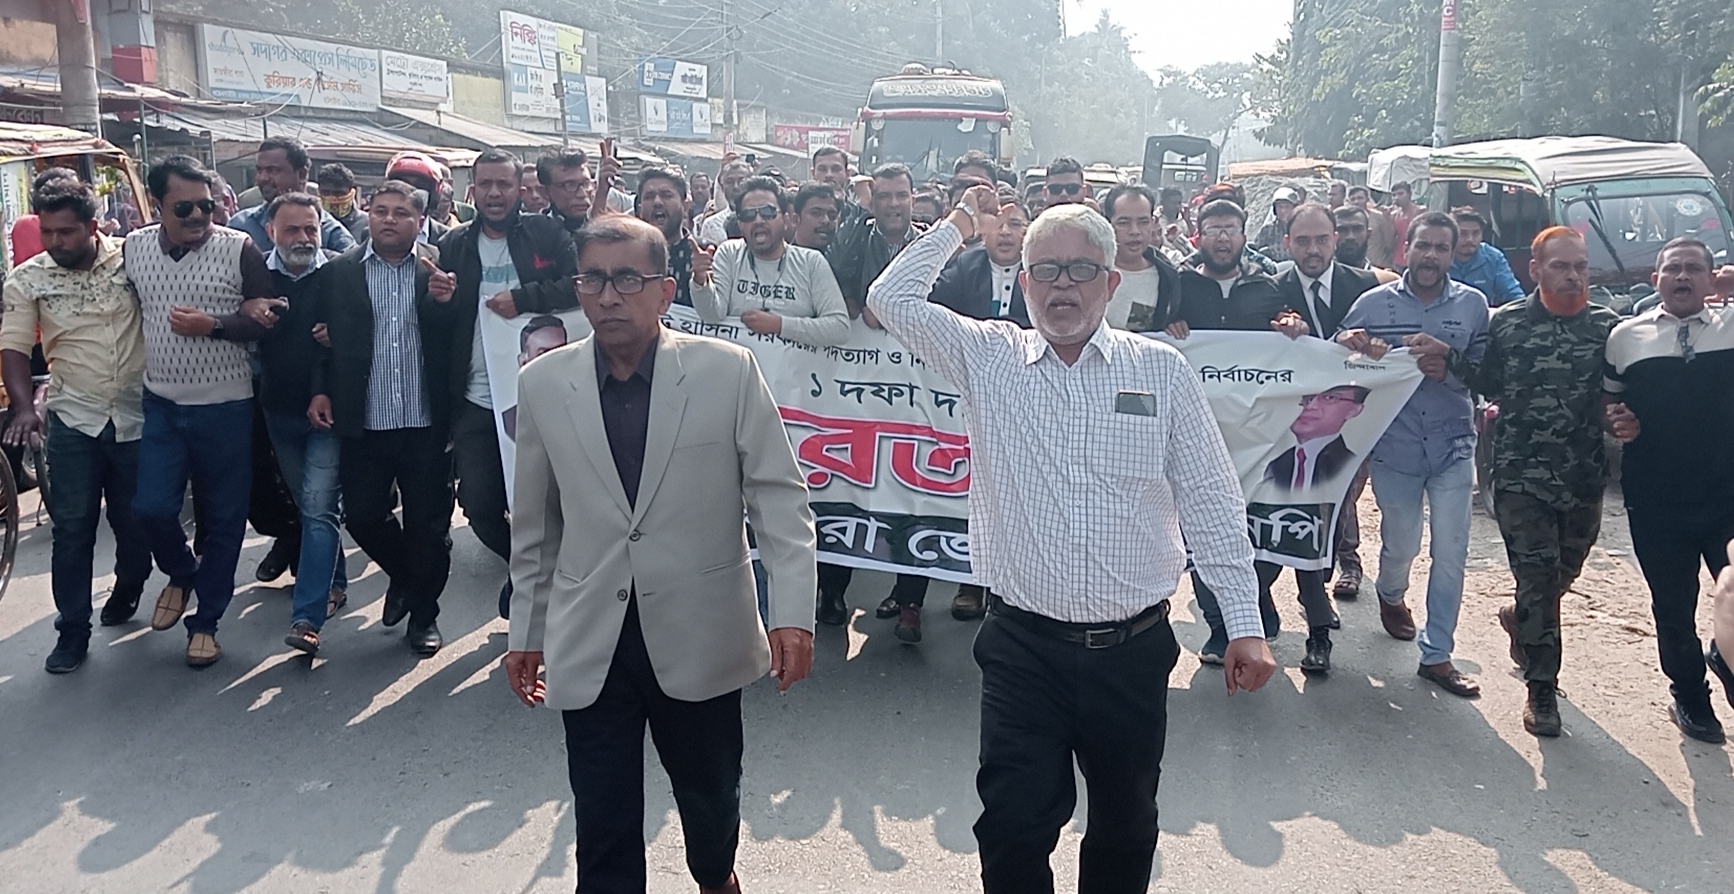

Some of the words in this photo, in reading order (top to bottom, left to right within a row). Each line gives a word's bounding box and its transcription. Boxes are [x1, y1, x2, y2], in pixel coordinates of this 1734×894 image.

[250, 41, 288, 62] সদাগর
[263, 70, 296, 89] কুরিয়ার
[737, 279, 796, 301] TIGER
[1199, 364, 1295, 385] নির্বাচনের
[833, 378, 922, 408] দফা
